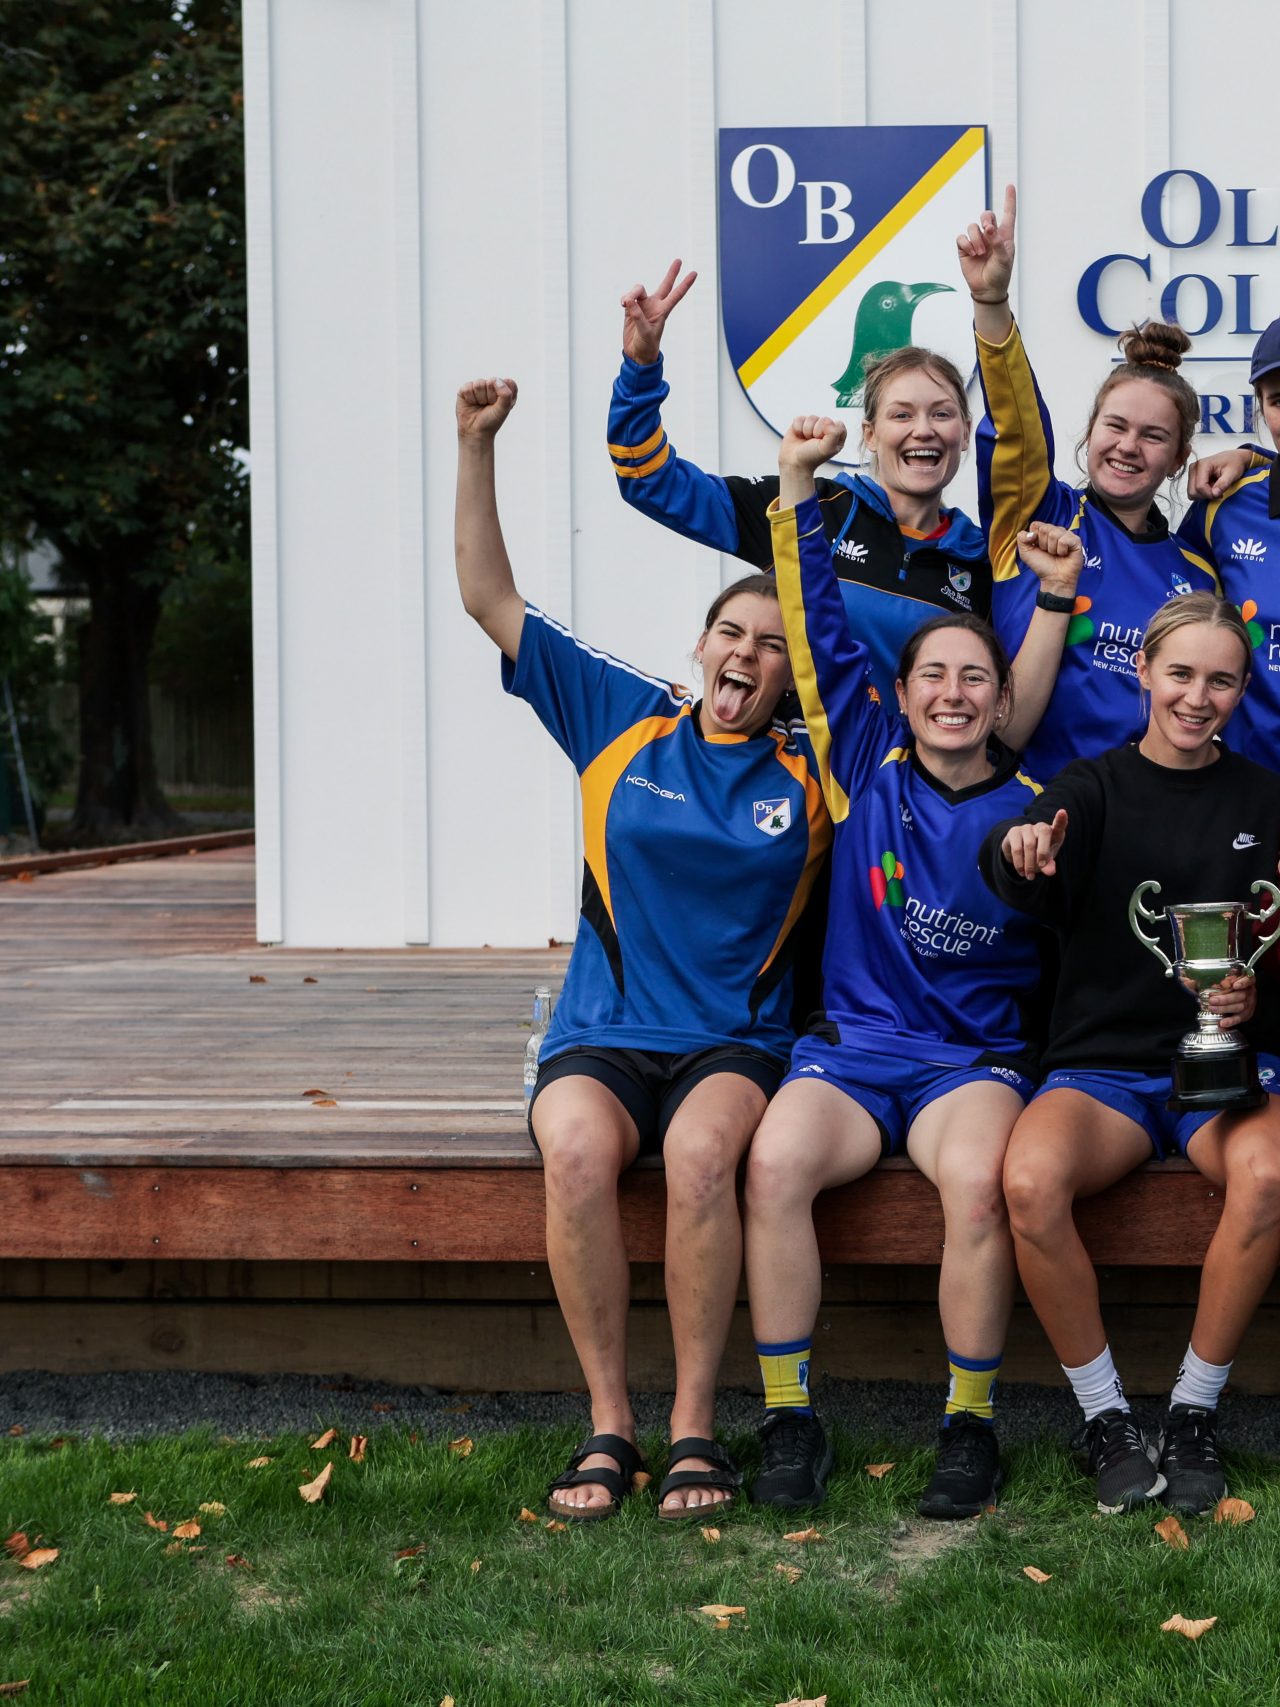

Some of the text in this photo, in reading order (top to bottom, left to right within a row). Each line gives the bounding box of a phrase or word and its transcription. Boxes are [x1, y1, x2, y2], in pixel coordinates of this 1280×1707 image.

[731, 144, 855, 244] OB
[836, 549, 867, 564] ALADIN
[1230, 554, 1265, 563] PALADIN
[1093, 641, 1139, 669] resc
[1092, 659, 1109, 670] NEW
[756, 802, 774, 815] OB
[1237, 832, 1256, 844] NIKE
[905, 896, 999, 946] nutrient
[903, 913, 972, 957] rescue
